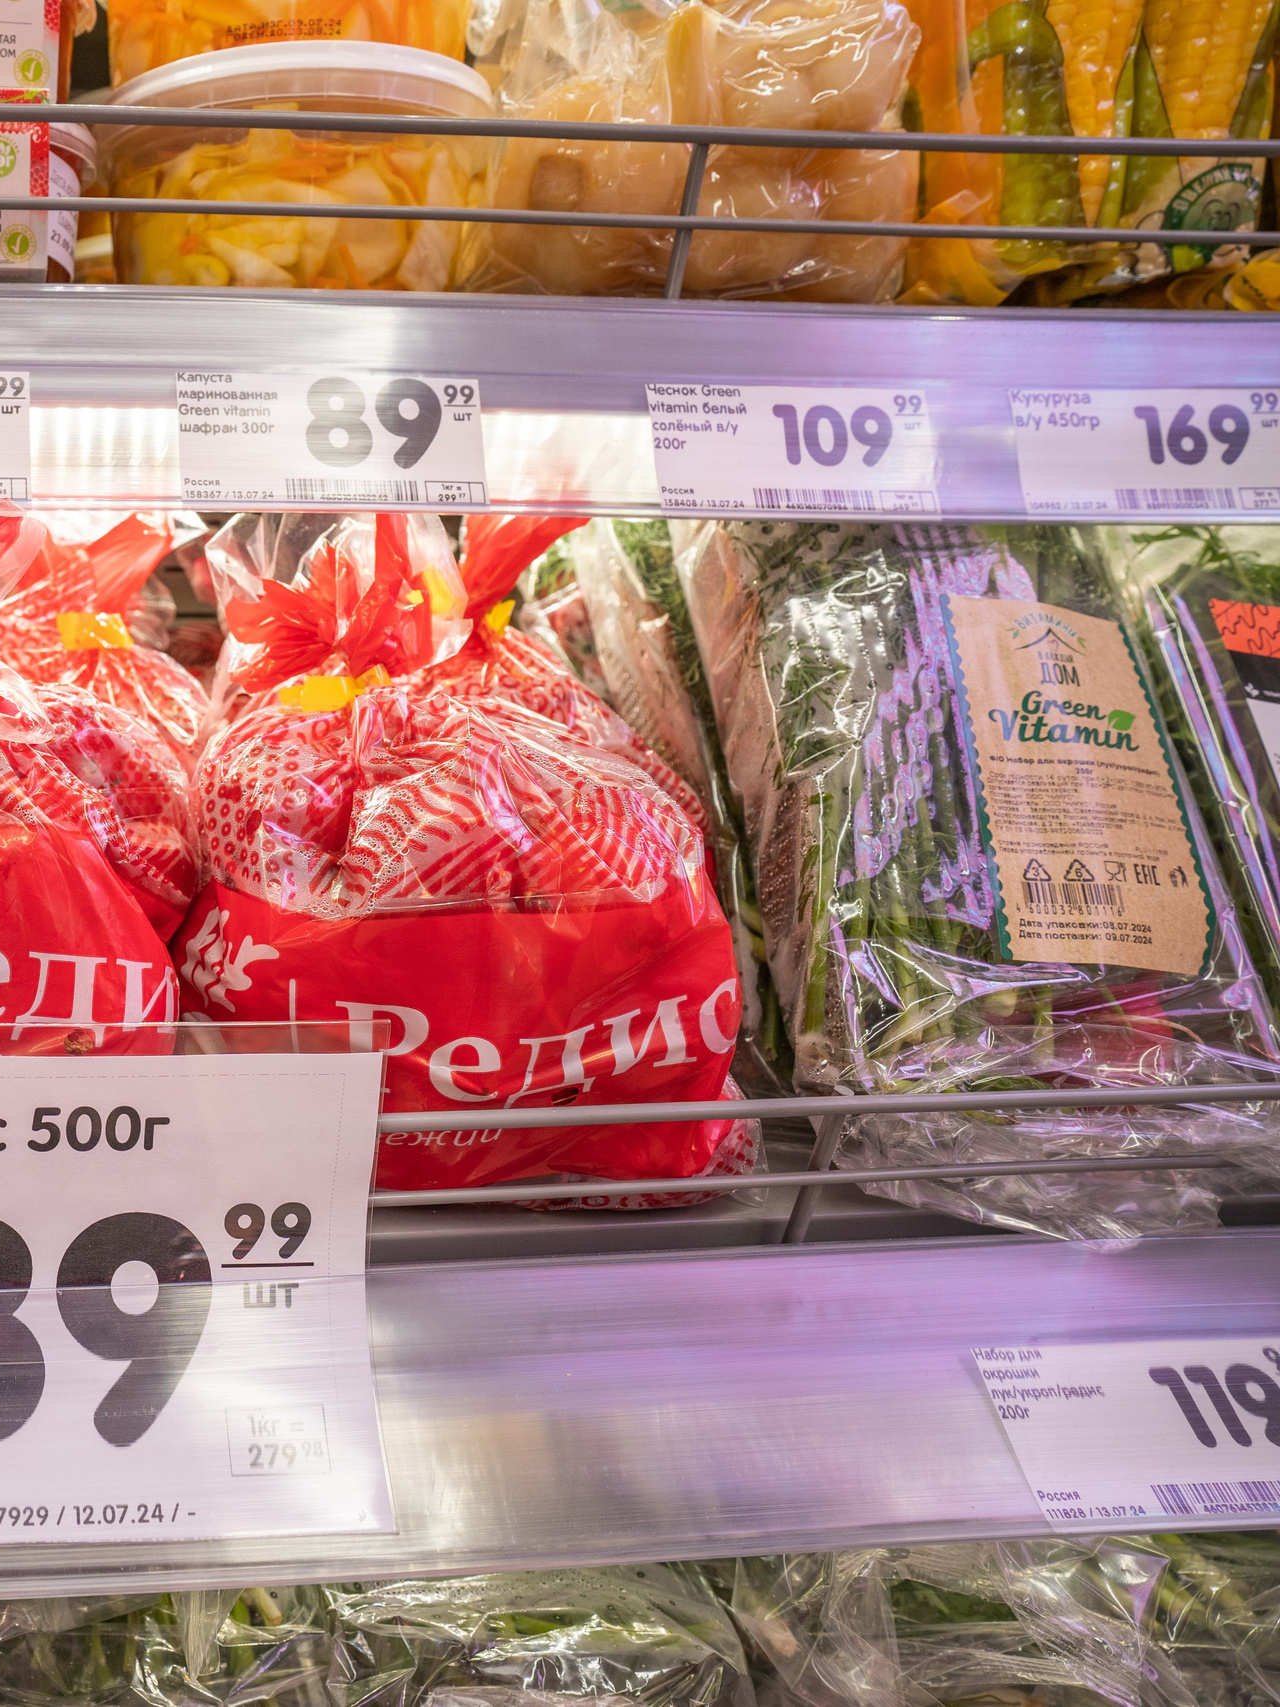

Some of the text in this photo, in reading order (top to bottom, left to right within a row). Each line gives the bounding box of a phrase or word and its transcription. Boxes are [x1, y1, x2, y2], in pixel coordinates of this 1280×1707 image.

[177, 372, 232, 385] Капуста
[179, 391, 278, 401] маринованная
[444, 385, 474, 404] 99
[648, 384, 740, 397] Чеснок Green
[894, 395, 921, 414] 99
[1011, 391, 1091, 407] Кукуруза
[1250, 393, 1278, 410] 99
[1, 405, 21, 414] шт
[179, 405, 271, 417] Green vitamin
[650, 402, 747, 414] vitamin белый
[305, 376, 442, 469] 89
[453, 412, 472, 421] шт
[1016, 413, 1100, 430] в/у 450гр
[1261, 419, 1279, 427] шт
[180, 422, 274, 435] шафран 300г
[653, 419, 738, 435] солёный в/у
[904, 422, 920, 430] шт
[773, 404, 893, 467] 109
[1134, 404, 1250, 465] 169
[654, 438, 686, 449] 200г
[185, 478, 220, 486] Россия
[185, 490, 273, 499] 158367 13.07.24
[662, 487, 694, 495] Россия
[664, 498, 744, 508] 158408 13.07.24
[1040, 662, 1080, 687] ДОМ
[1021, 690, 1106, 720] Green
[989, 708, 1139, 752] Vitamin
[1020, 919, 1043, 929] Дата
[1019, 930, 1043, 939] Дата
[1105, 933, 1152, 945] 09.07.2024
[335, 978, 740, 1109] Редис
[28, 1107, 169, 1152] 500г
[223, 1203, 312, 1259] 99
[243, 1283, 299, 1308] шт
[973, 1350, 1042, 1362] Набор для
[983, 1368, 1039, 1382] окрошки
[998, 1405, 1029, 1419] 200г
[1149, 1364, 1280, 1448] 119
[248, 1415, 280, 1437] 1кг
[248, 1441, 323, 1469] 279 98
[1037, 1490, 1080, 1501] Россия
[73, 1505, 164, 1525] 12.07.24
[1046, 1505, 1146, 1519] 111828 13.07.24
